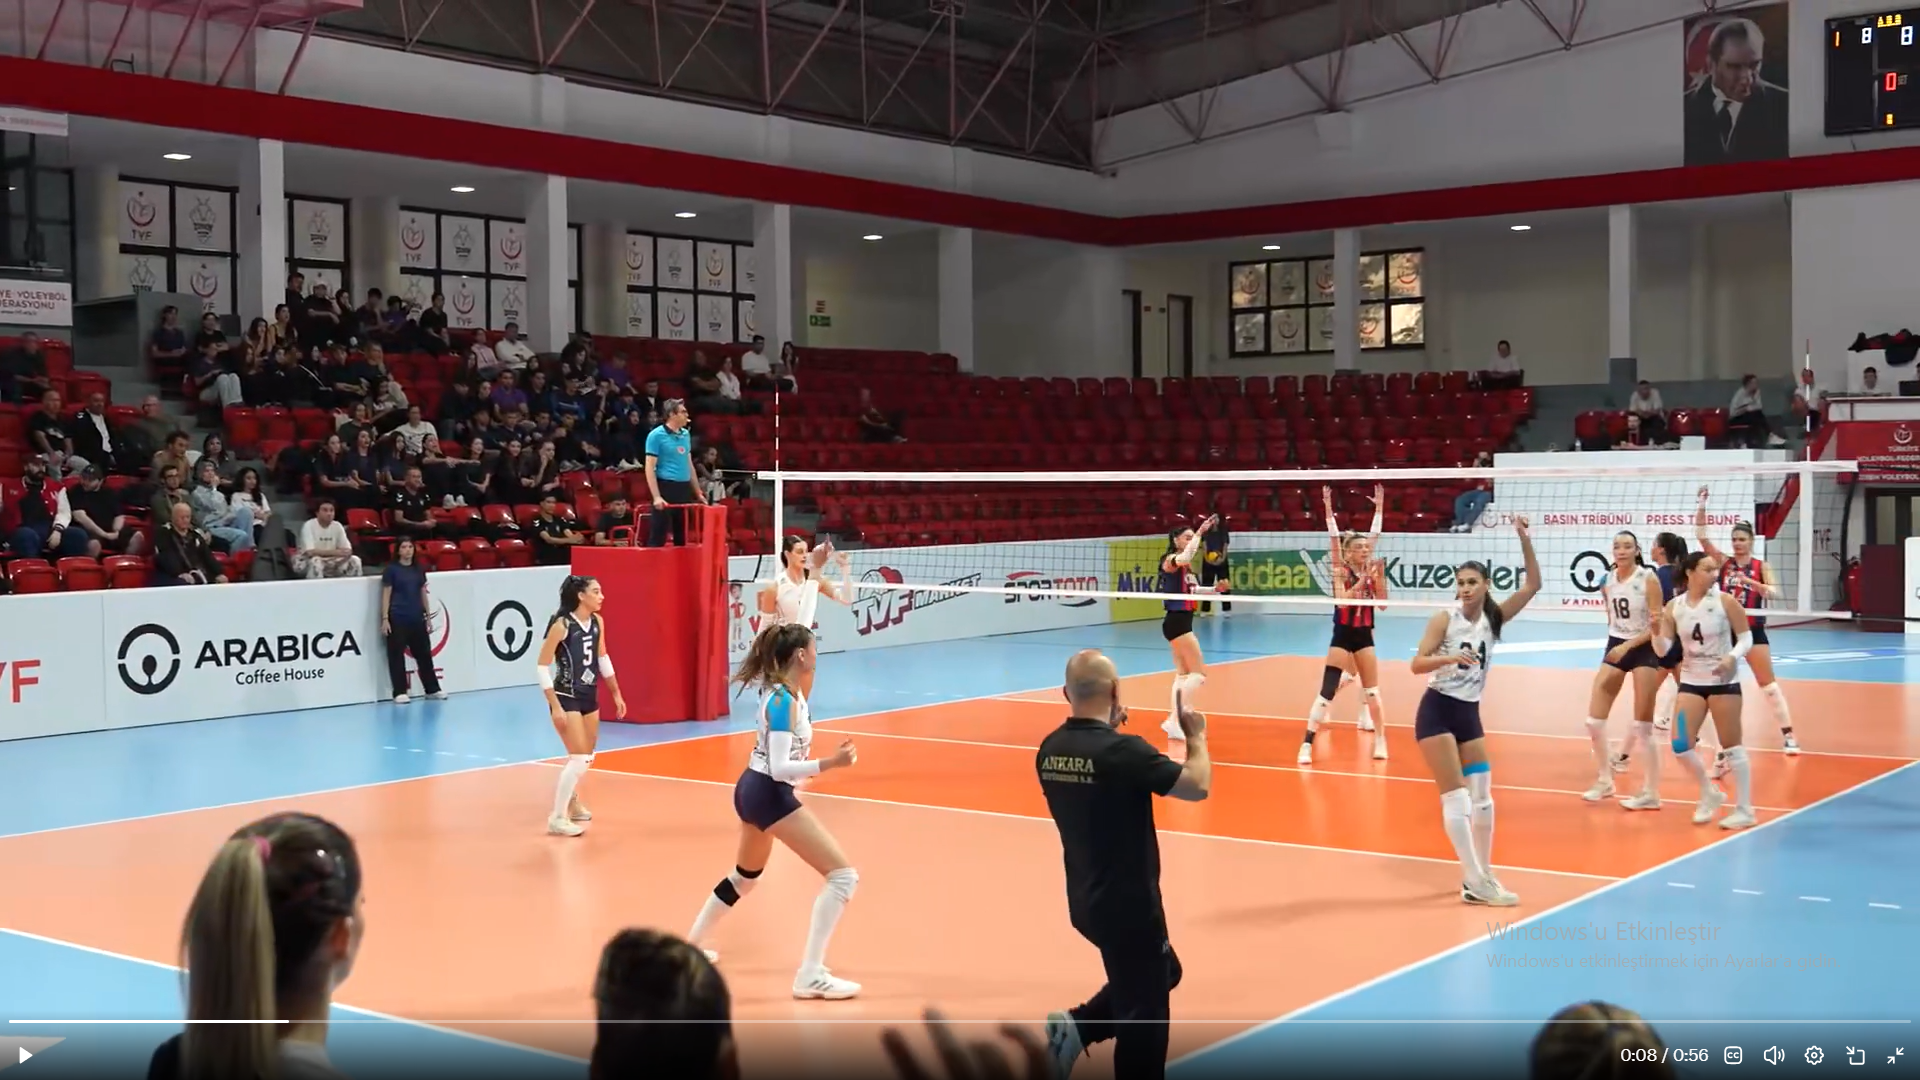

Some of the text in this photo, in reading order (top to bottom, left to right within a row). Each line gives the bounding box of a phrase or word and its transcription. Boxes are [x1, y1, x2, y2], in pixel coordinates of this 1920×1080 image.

[1861, 27, 1872, 44] 8
[1901, 26, 1913, 46] 8
[1885, 72, 1897, 91] 0
[0, 300, 55, 310] ERASYONU
[17, 291, 67, 301] VOLEYBOL
[1544, 514, 1578, 525] BASIN
[1646, 514, 1684, 525] PRESS
[1688, 514, 1741, 525] TBUNE
[1228, 557, 1311, 590] iddaa
[852, 588, 914, 637] TVF
[1612, 597, 1631, 619] 18
[1691, 622, 1704, 645] 4
[194, 630, 362, 669] ARABICA
[582, 641, 593, 666] 5
[236, 667, 325, 686] Coffee House
[1041, 755, 1095, 773] ANKARA
